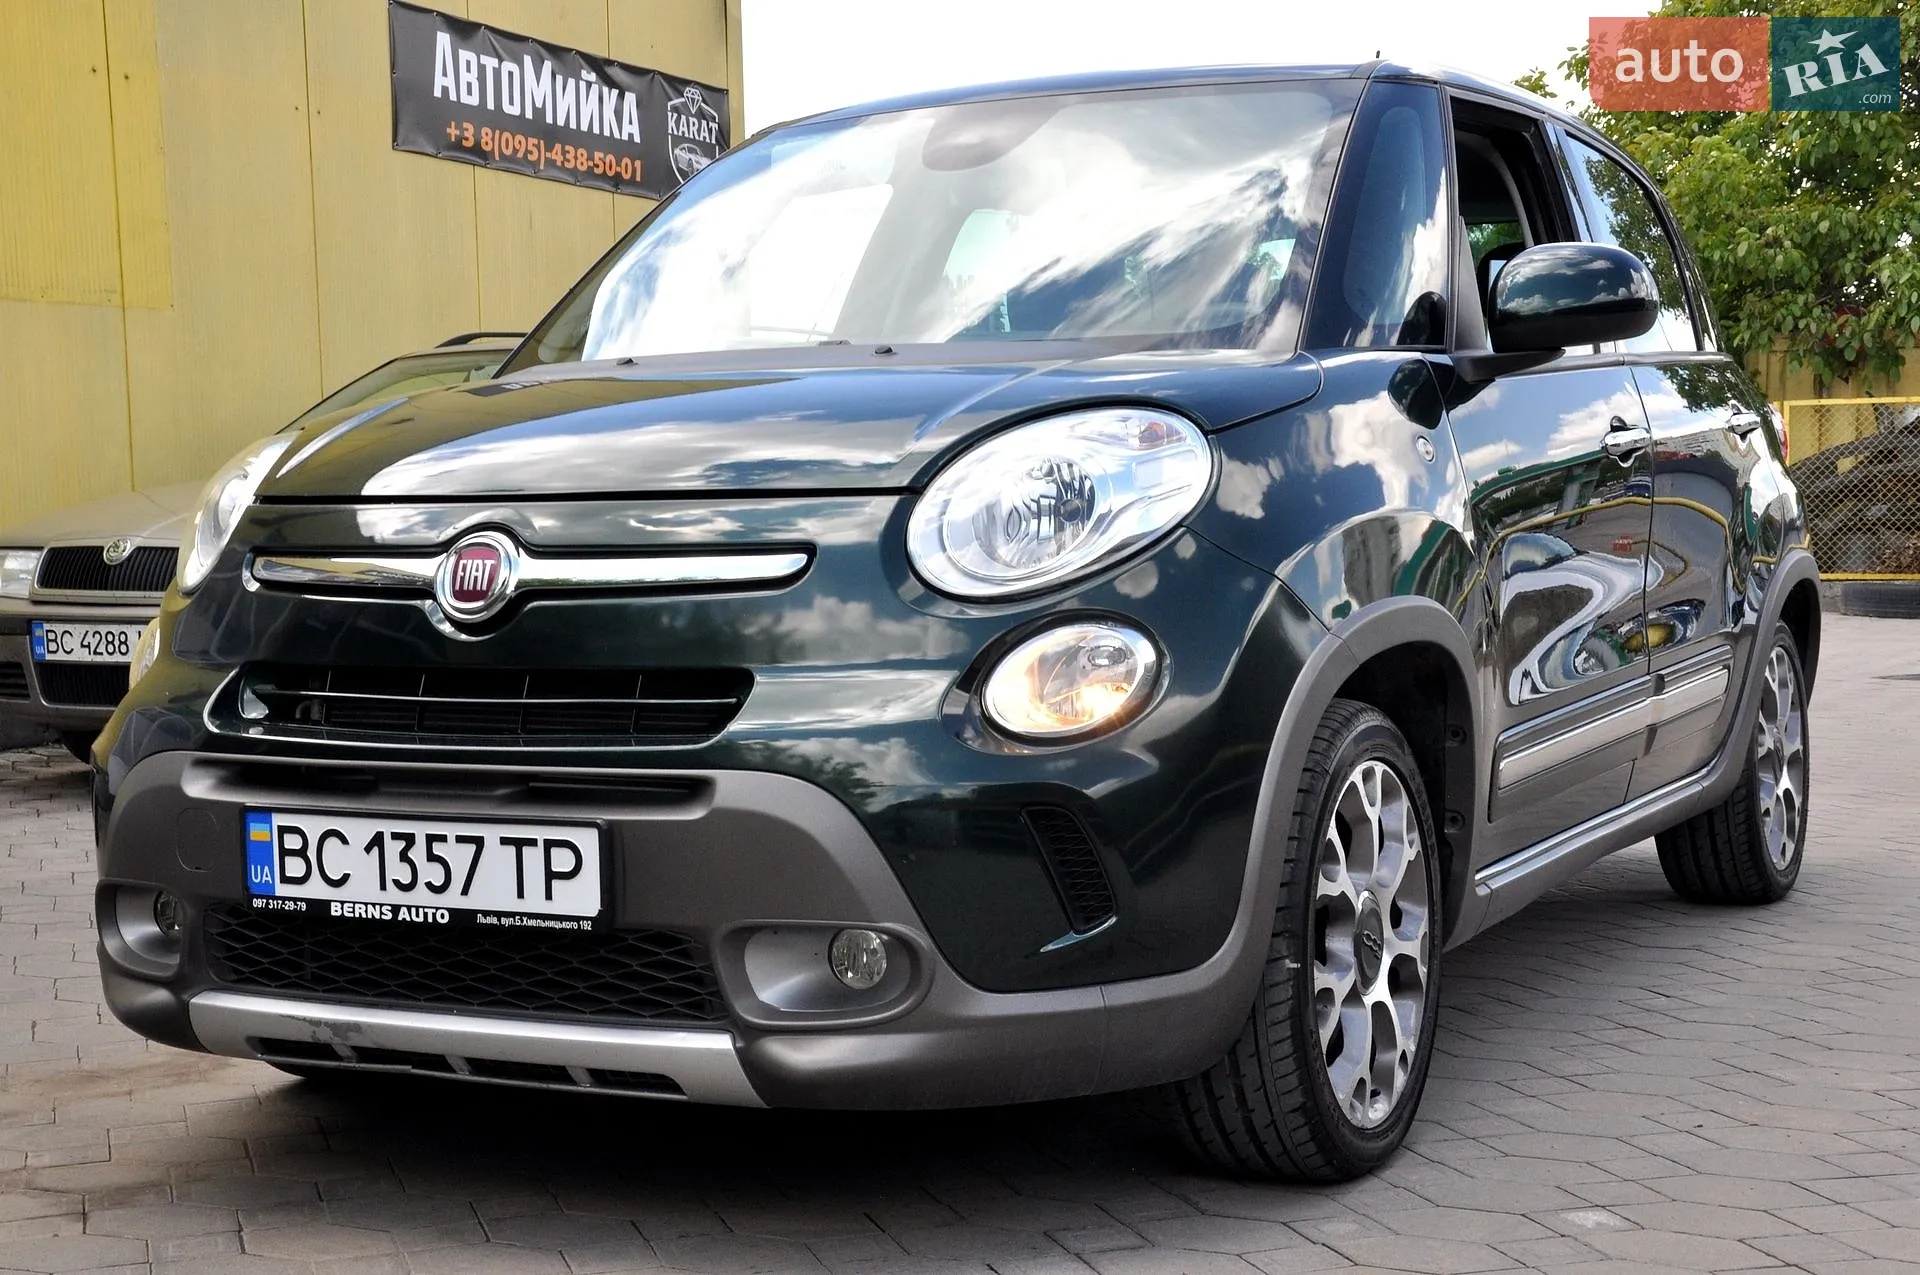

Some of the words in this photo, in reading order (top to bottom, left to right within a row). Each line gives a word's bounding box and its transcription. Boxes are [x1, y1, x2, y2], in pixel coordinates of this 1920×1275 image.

[433, 31, 641, 144] АвтоМийка
[667, 110, 718, 144] KARAT
[480, 126, 642, 182] 8(095)-438-50-01
[455, 559, 496, 591] FIAT
[46, 629, 74, 655] BC
[80, 630, 130, 656] 4288
[251, 864, 272, 884] UA
[277, 825, 351, 888] BC
[363, 830, 485, 896] 1357
[499, 836, 584, 901] TP
[253, 898, 266, 908] 097
[268, 899, 306, 912] 317-29-79
[330, 901, 393, 920] BERNS
[397, 906, 450, 924] AUTO
[477, 914, 500, 926] Львів,
[580, 920, 592, 930] 192
